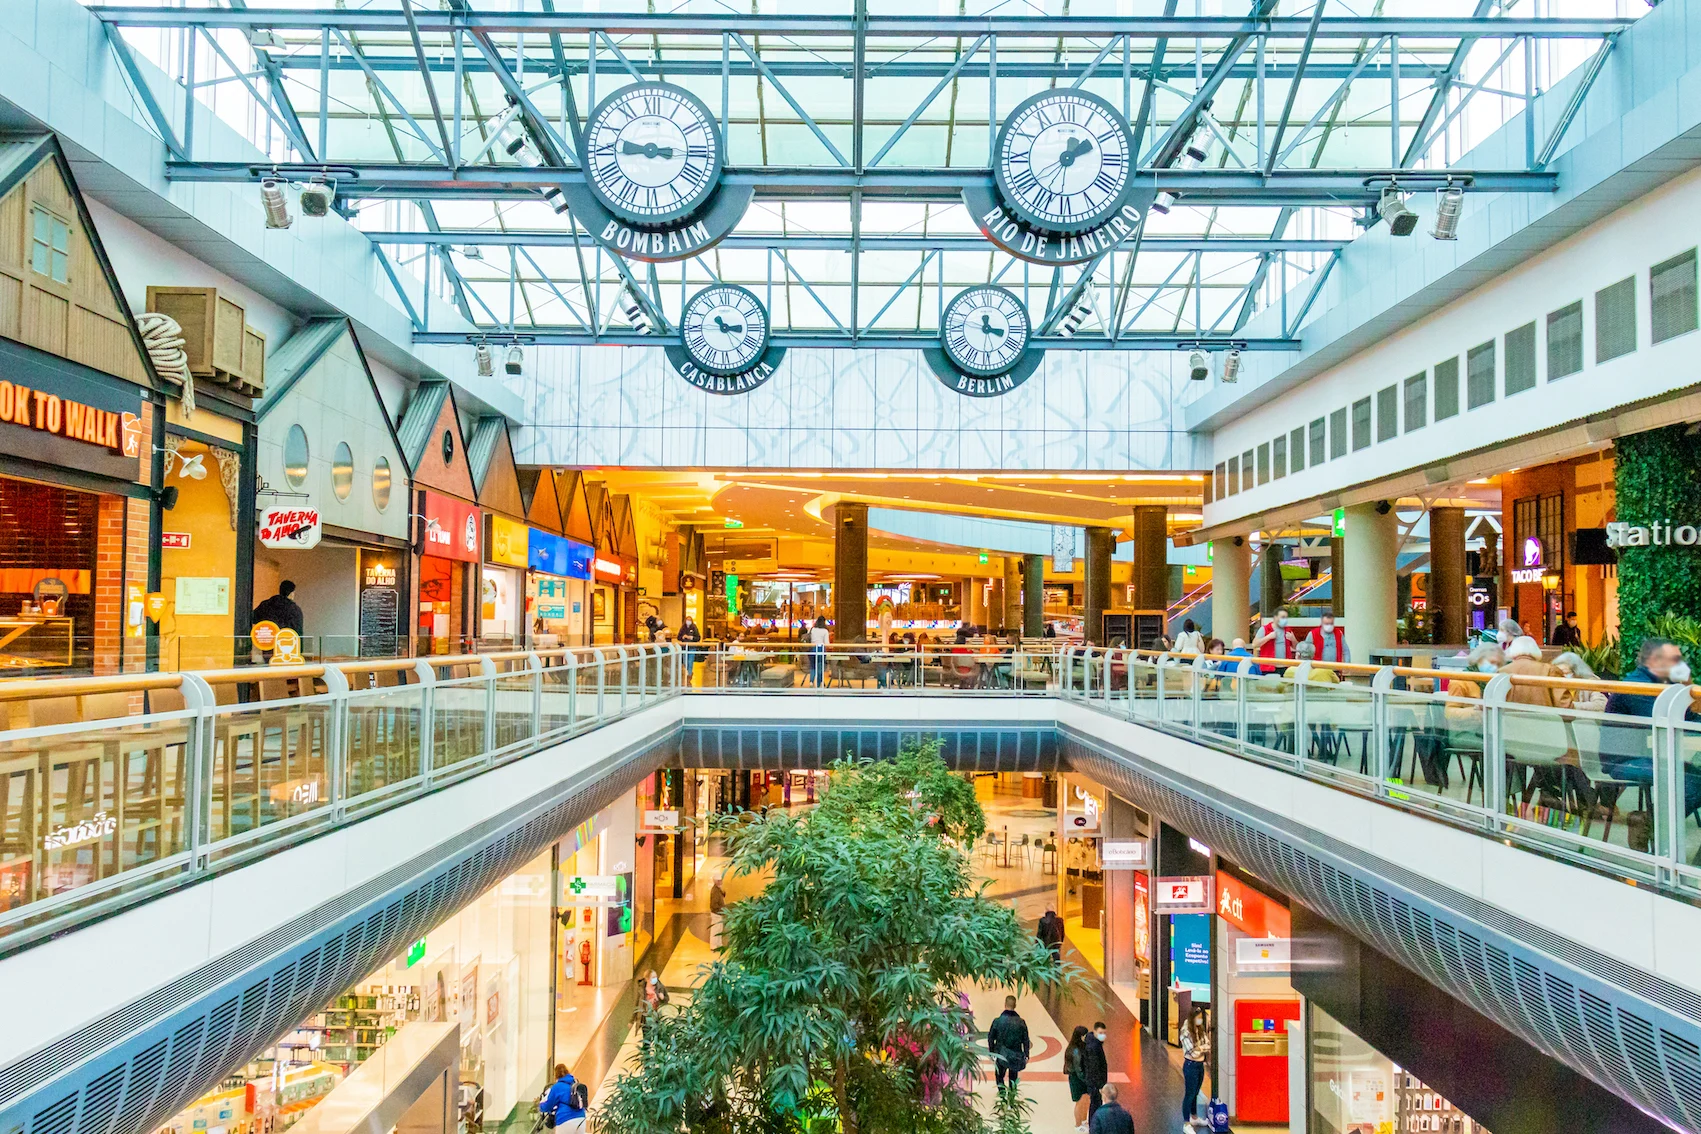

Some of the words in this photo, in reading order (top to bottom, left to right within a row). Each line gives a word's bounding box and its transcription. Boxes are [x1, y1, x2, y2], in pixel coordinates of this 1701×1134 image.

[601, 220, 711, 254] BOMBAIM
[982, 206, 1019, 242] RIO
[1020, 232, 1048, 258] DE
[1056, 204, 1141, 260] JANEIRO
[680, 361, 774, 391] CASABLANCA
[956, 374, 1014, 394] BERLIM
[34, 390, 61, 433] TO
[65, 399, 118, 448] WALK
[268, 510, 318, 526] TAVERNA
[1606, 518, 1701, 548] Statio
[366, 568, 396, 577] TAVERNA
[366, 576, 376, 585] DO
[377, 576, 396, 586] ALHO
[1511, 570, 1533, 583] TACO
[1468, 592, 1490, 606] NOS
[1232, 898, 1243, 922] ctt
